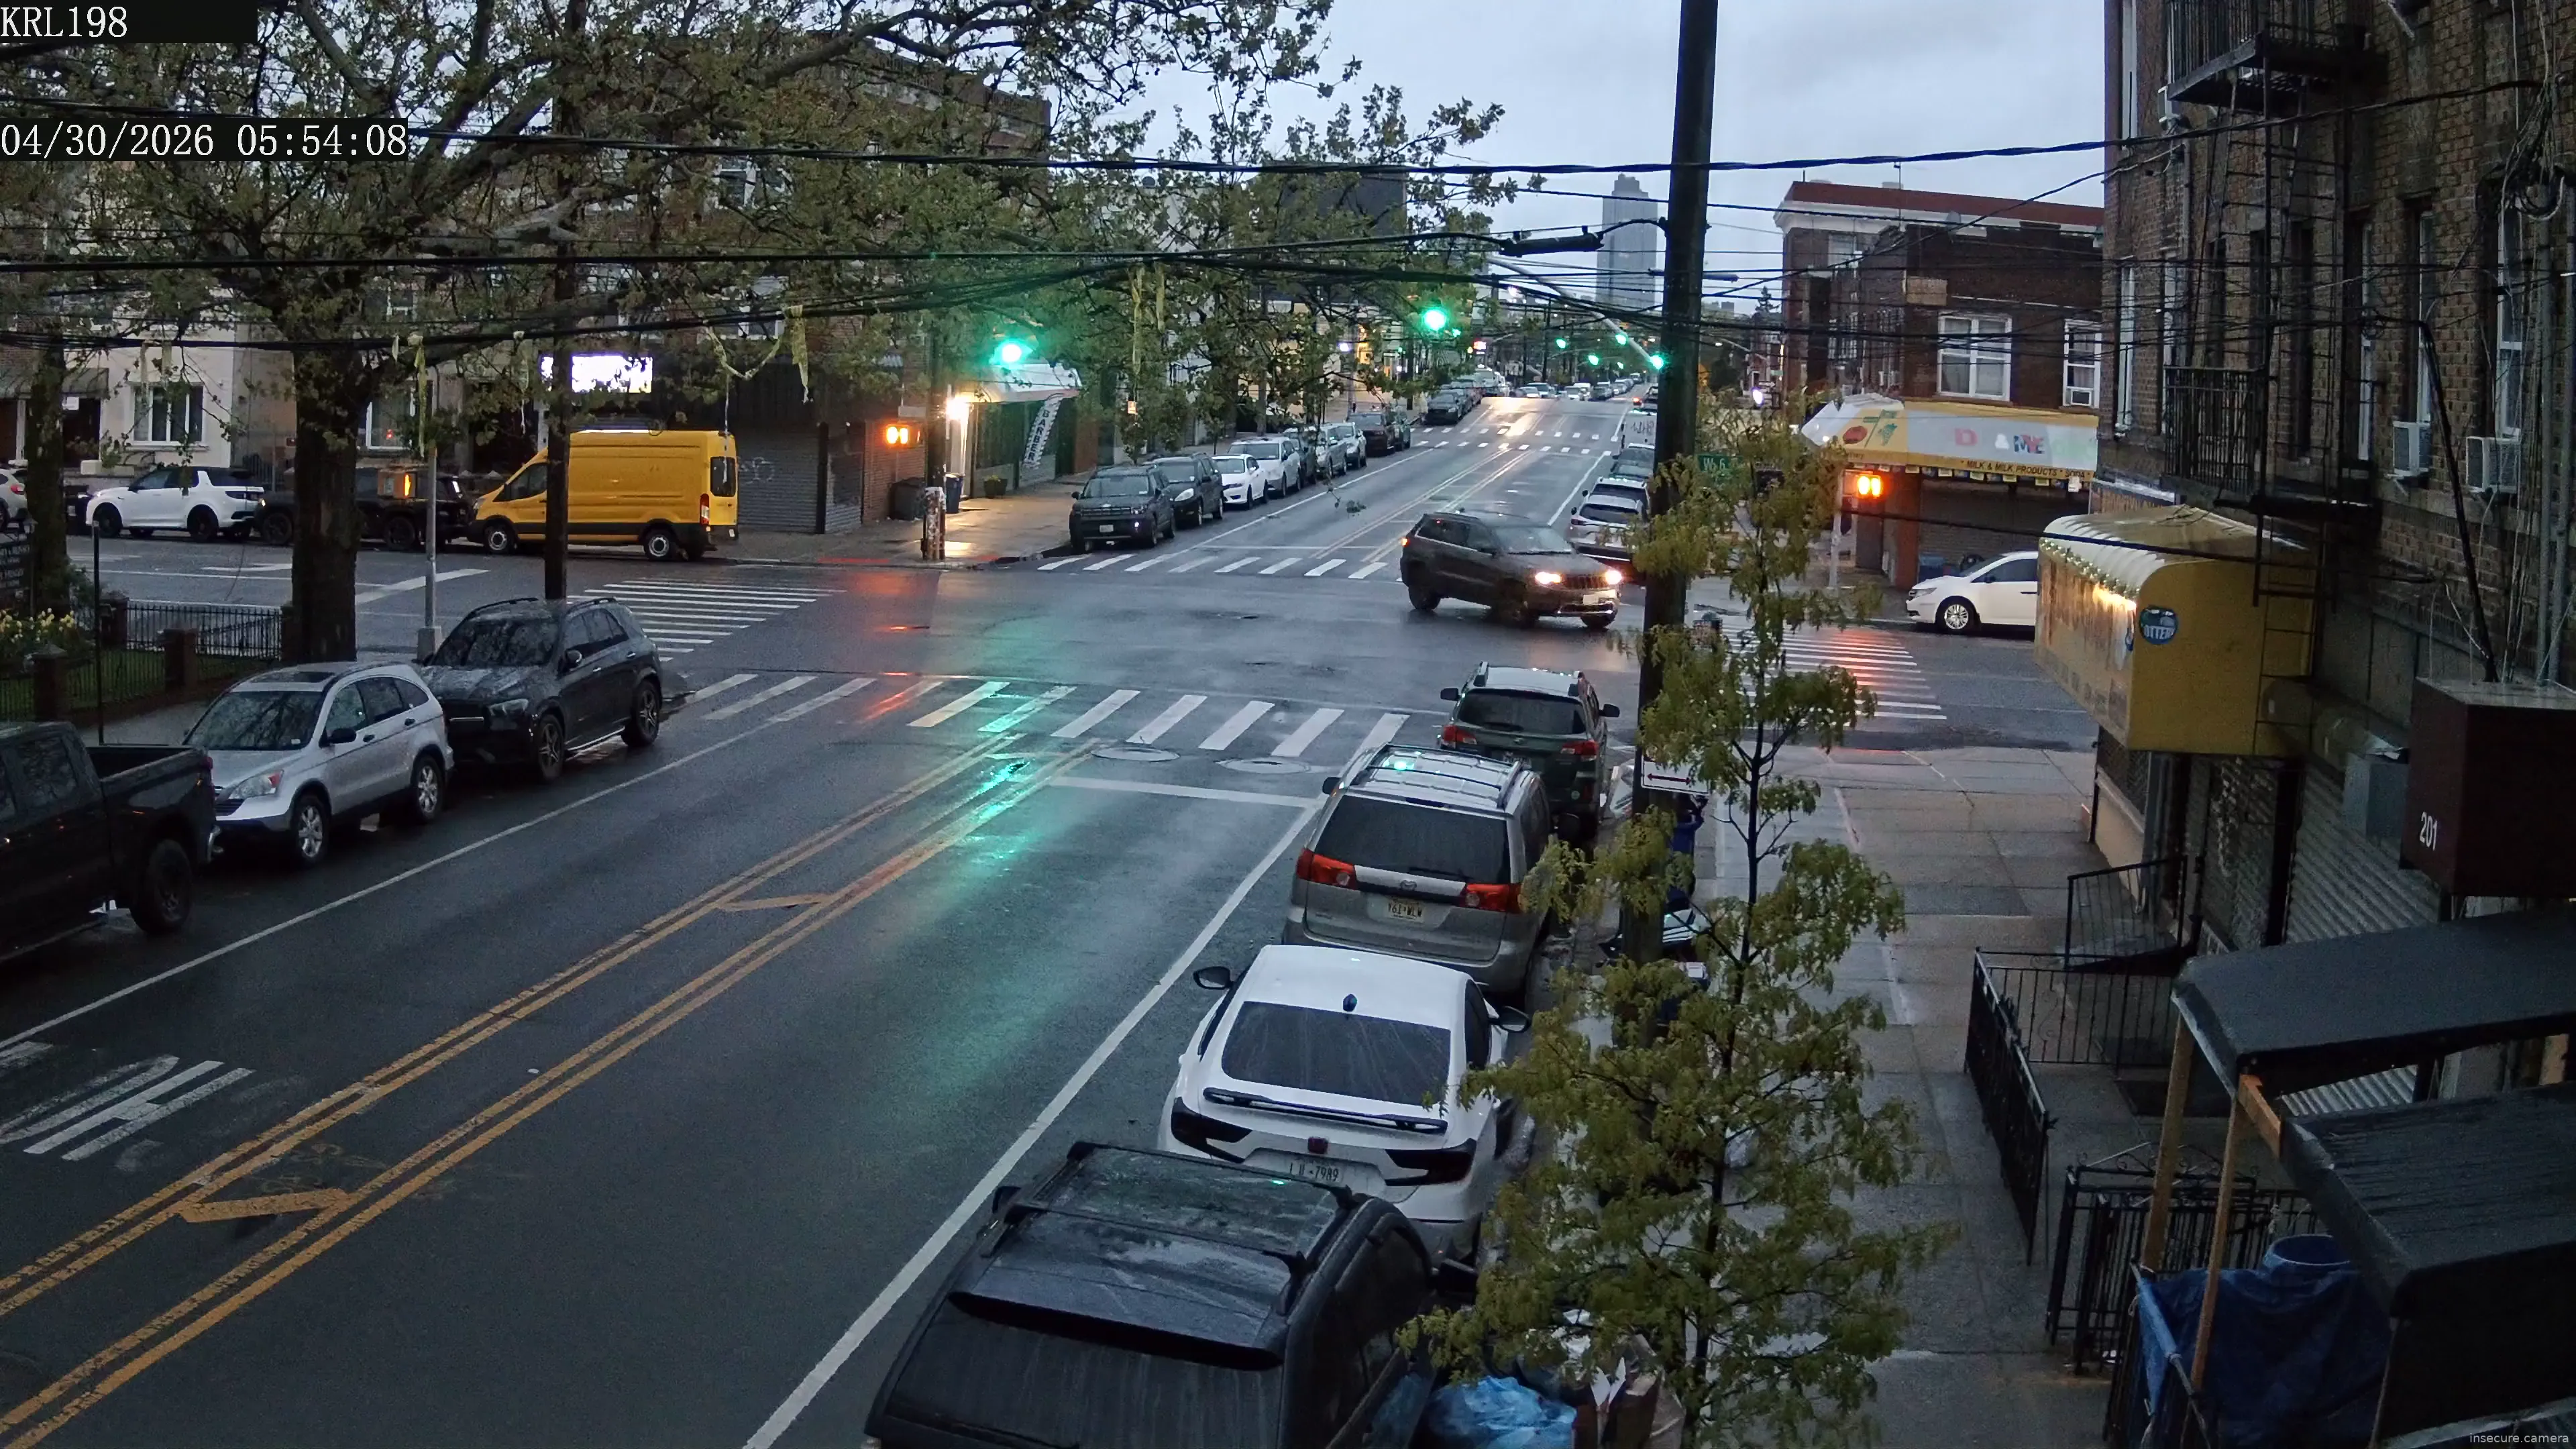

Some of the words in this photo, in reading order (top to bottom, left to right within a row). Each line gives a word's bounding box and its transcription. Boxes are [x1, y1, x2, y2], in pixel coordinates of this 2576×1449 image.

[1027, 409, 1050, 462] BARBER
[1966, 460, 1984, 470] MILK
[1995, 462, 2014, 472] MILK
[2016, 464, 2058, 477] PRODUCTS
[2419, 811, 2438, 851] 201
